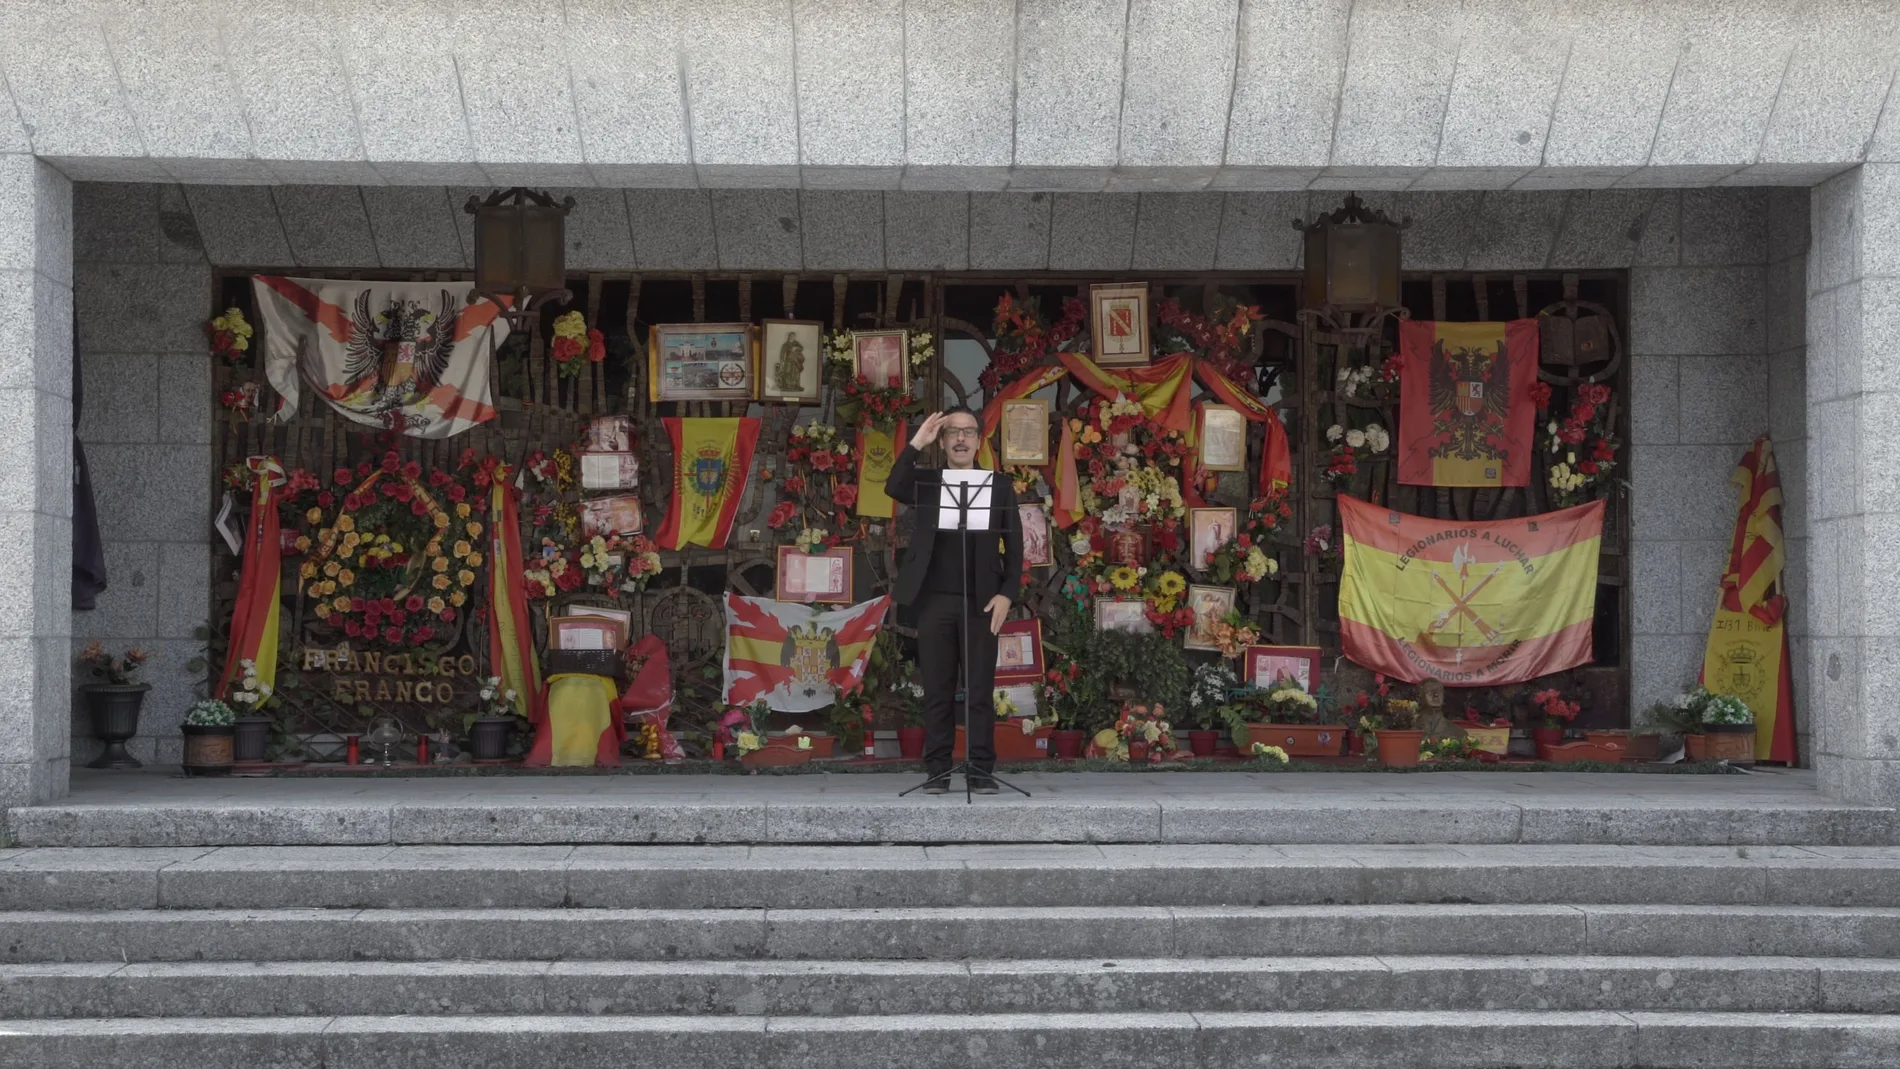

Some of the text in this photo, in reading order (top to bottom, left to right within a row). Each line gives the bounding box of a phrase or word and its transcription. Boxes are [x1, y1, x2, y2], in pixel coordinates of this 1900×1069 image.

[1395, 528, 1535, 575] LEGIONARIOS A LUCHAR
[1396, 636, 1523, 682] LEGIONARIOS A MORIR
[333, 679, 454, 705] FRANCO
